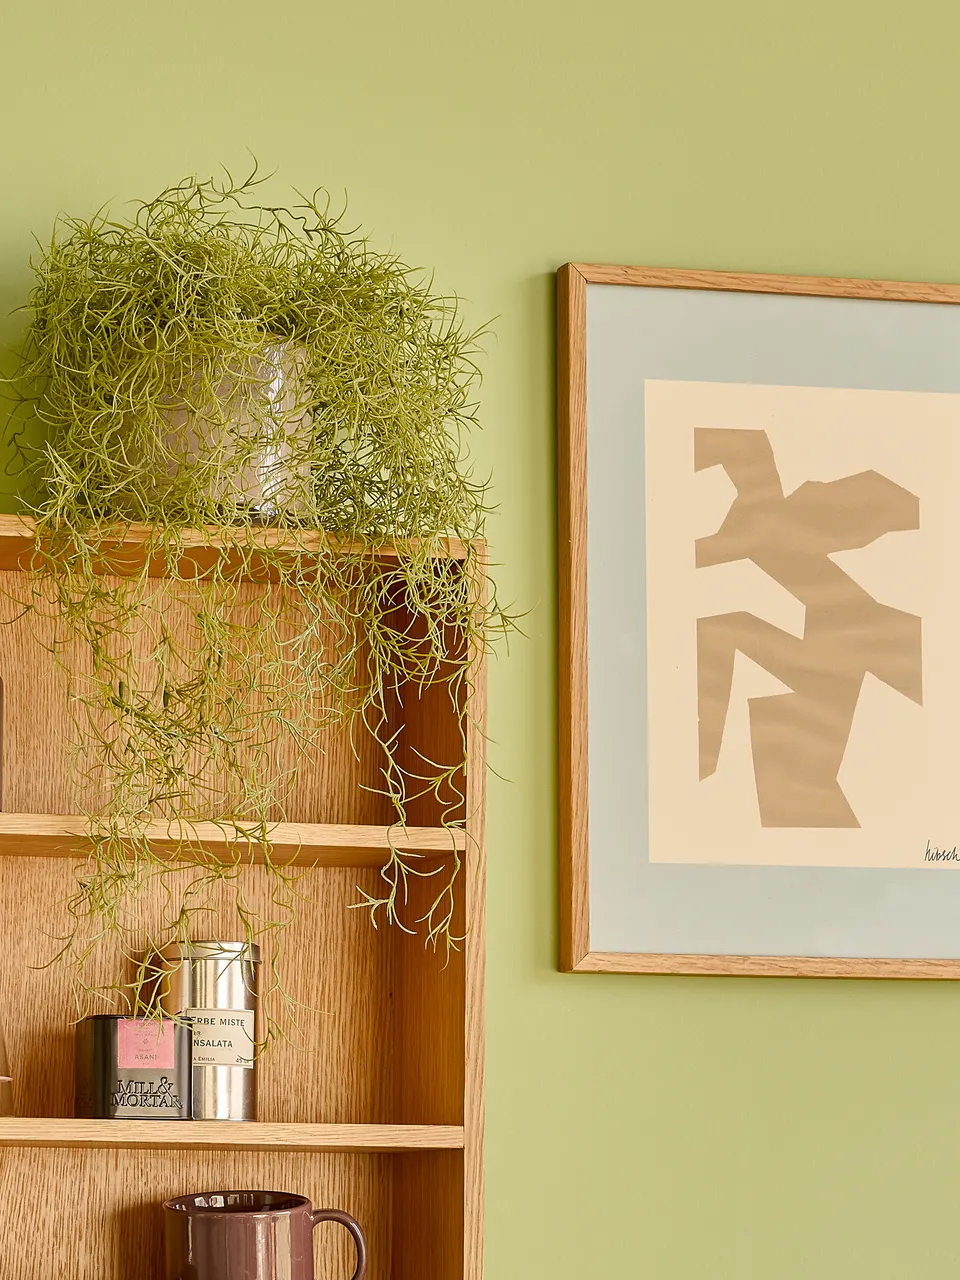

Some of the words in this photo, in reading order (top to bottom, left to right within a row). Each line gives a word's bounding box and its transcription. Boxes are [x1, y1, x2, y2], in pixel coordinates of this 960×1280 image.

[219, 1018, 245, 1027] MISTE
[193, 1039, 233, 1048] NSALATA
[111, 1093, 183, 1109] MORTAR
